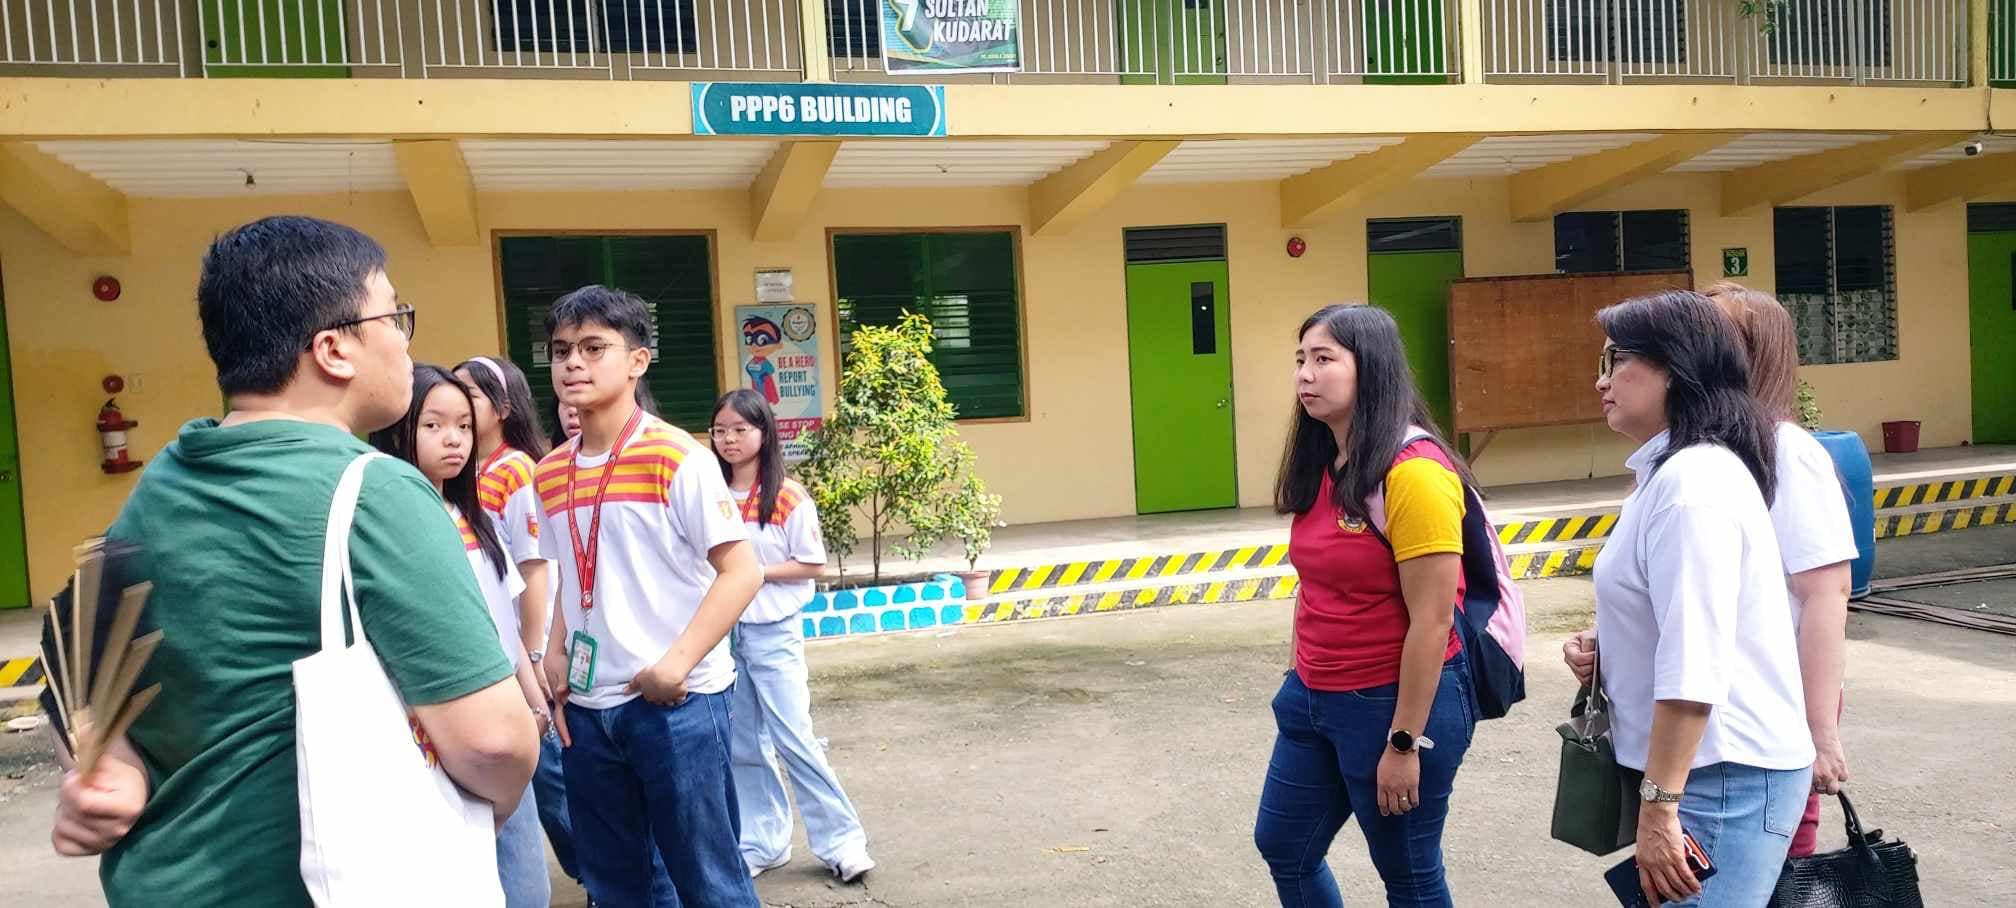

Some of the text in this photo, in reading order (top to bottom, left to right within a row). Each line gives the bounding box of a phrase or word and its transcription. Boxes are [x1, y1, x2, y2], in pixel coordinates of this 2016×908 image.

[925, 0, 988, 18] SULTAN
[933, 20, 1013, 42] KUDARAT
[730, 95, 912, 123] PPP6 BUILDING
[1731, 257, 1740, 274] 3
[778, 357, 787, 368] BE
[795, 355, 816, 367] HERO
[779, 371, 807, 383] REPORT
[780, 384, 816, 397] BULLYING
